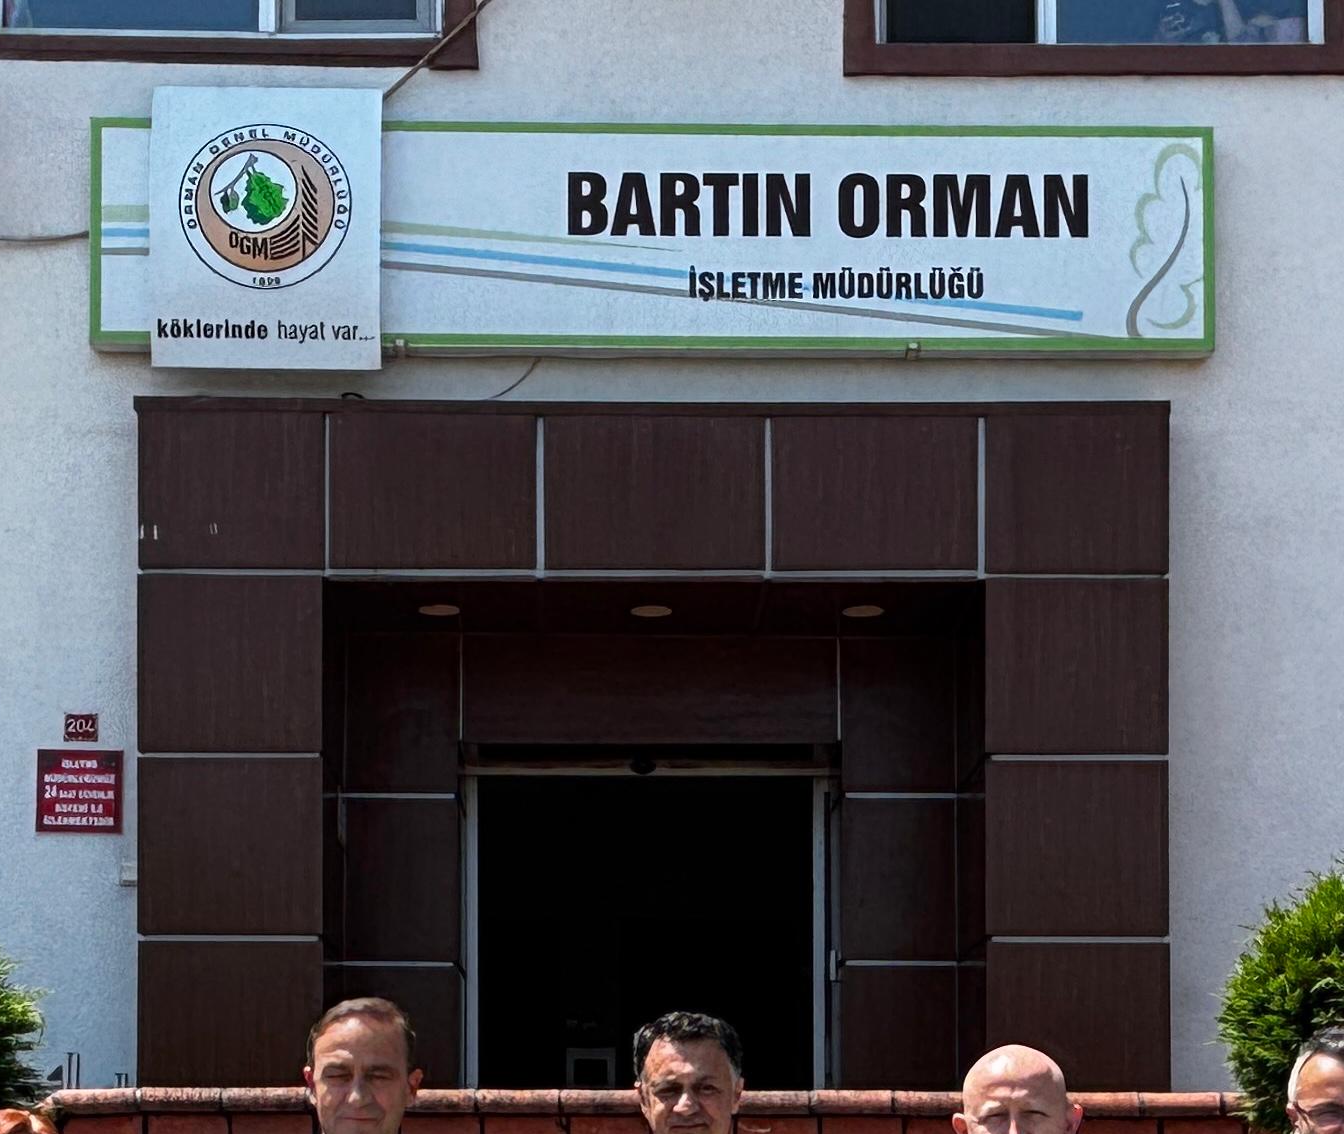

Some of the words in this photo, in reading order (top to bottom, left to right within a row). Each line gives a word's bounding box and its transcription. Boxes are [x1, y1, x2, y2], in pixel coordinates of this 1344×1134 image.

[567, 171, 811, 237] BARTIN
[838, 172, 1089, 239] ORMAN
[229, 231, 269, 260] OGM
[689, 264, 803, 302] İŞLETME
[812, 266, 984, 300] MÜDÜRLÜĞÜ
[158, 318, 268, 340] köklerinde
[277, 319, 325, 344] hayat
